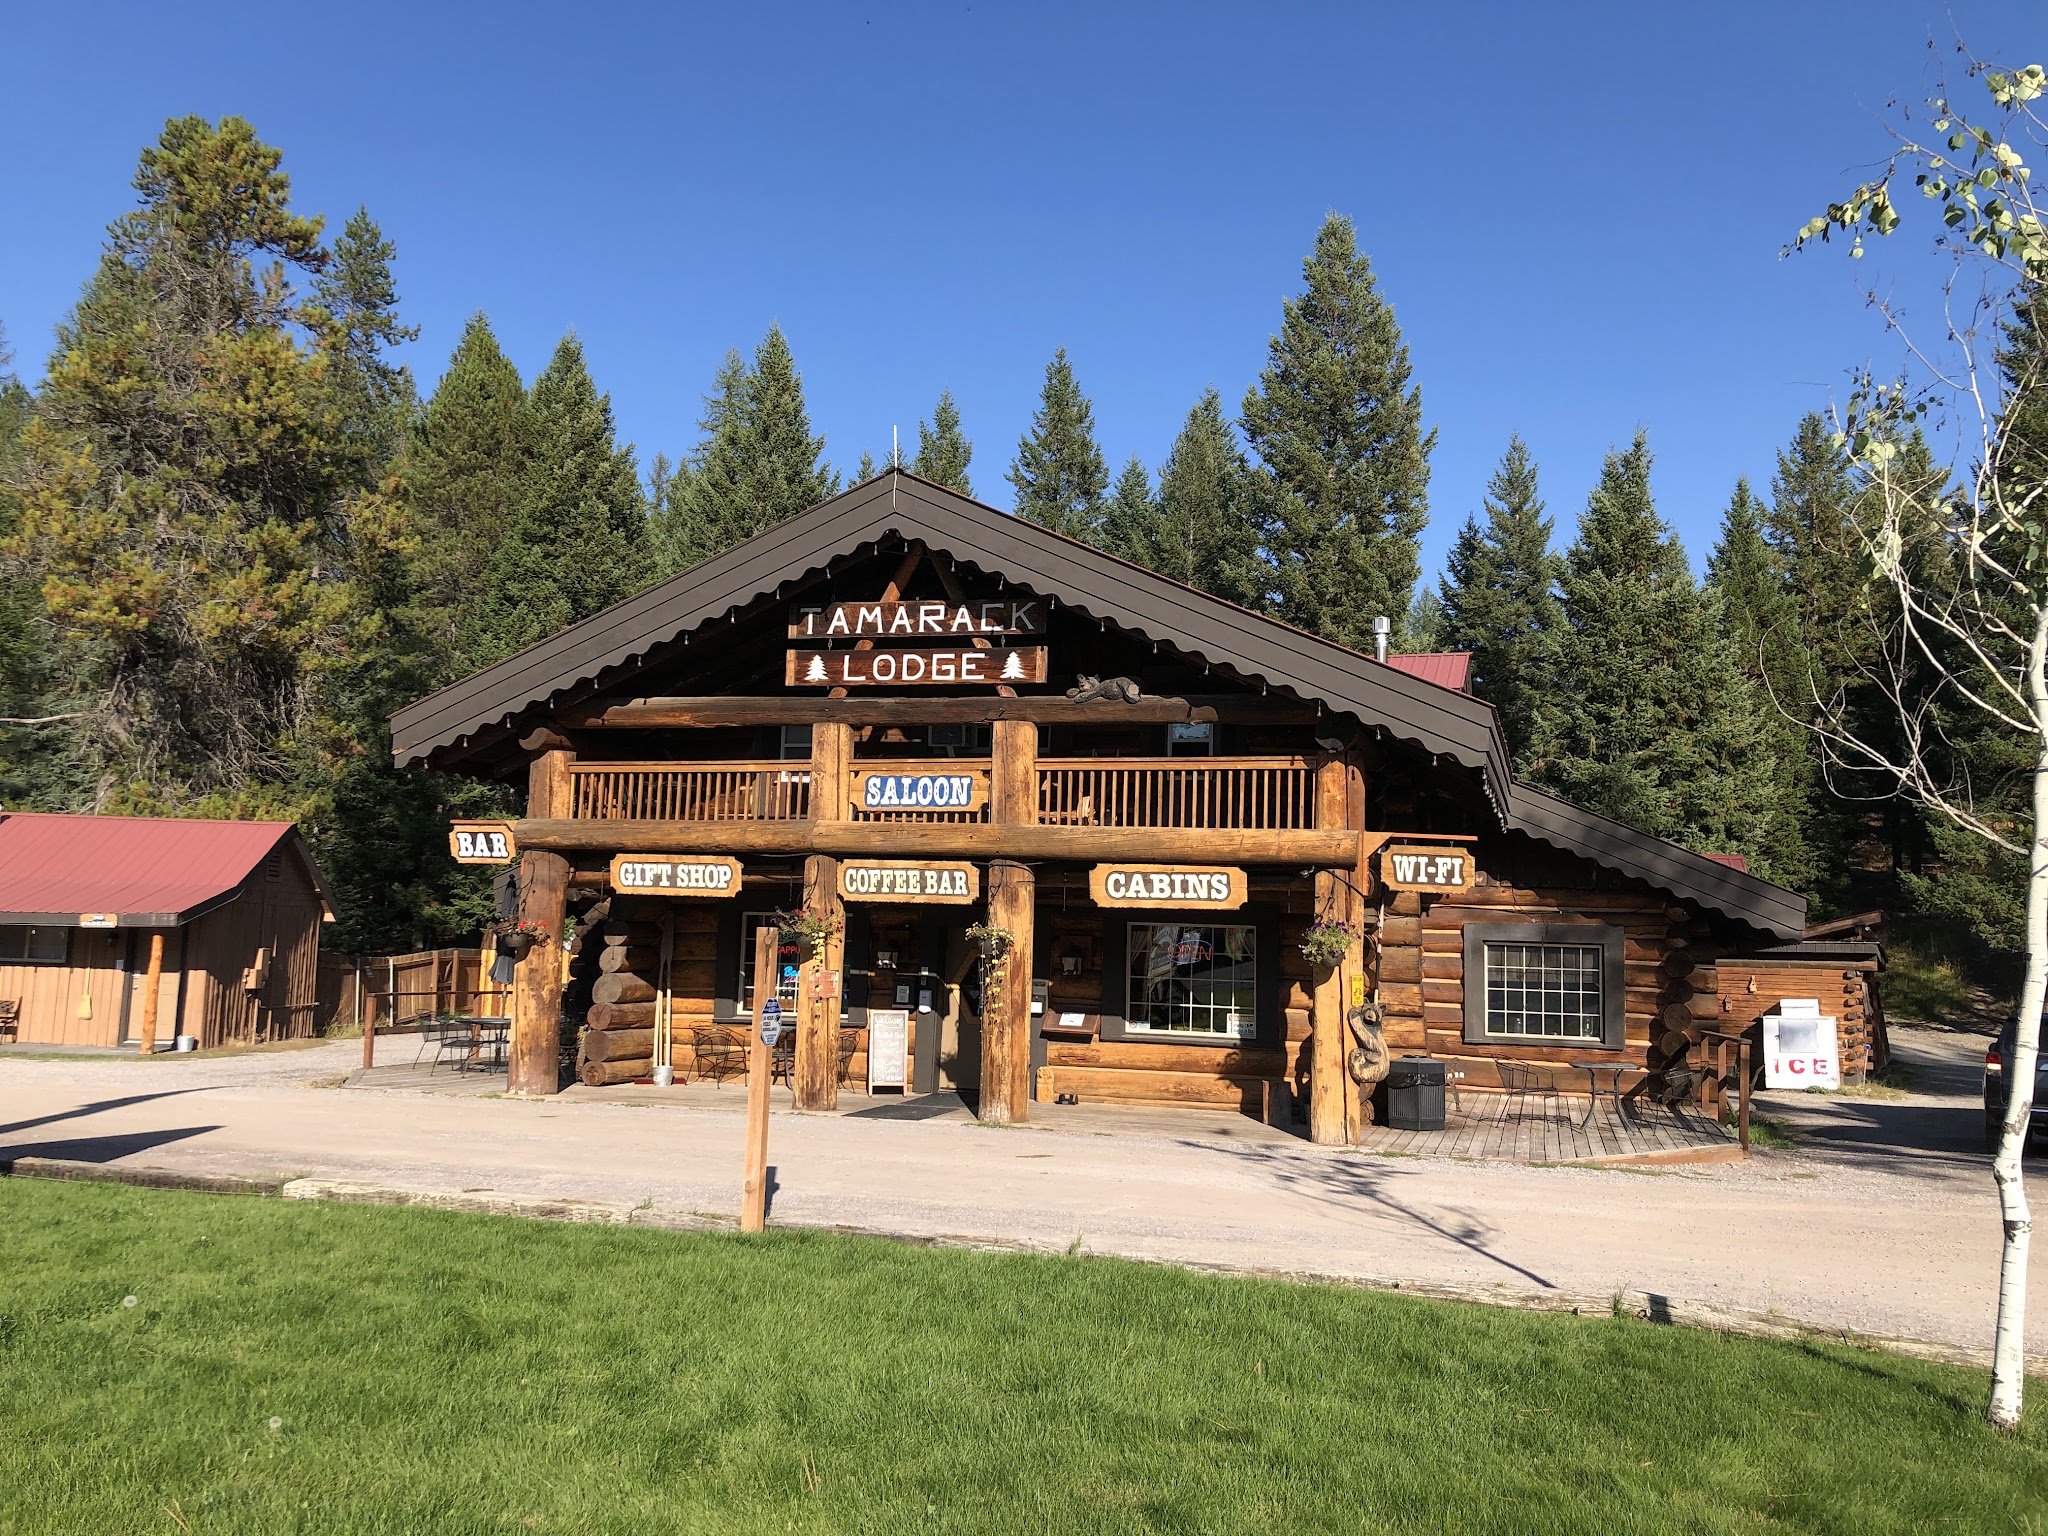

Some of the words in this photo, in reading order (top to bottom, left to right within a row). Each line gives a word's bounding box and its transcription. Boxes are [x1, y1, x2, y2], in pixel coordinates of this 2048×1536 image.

[800, 602, 1037, 634] TAMARACK
[843, 652, 986, 681] LODGE
[866, 777, 971, 805] SALOON
[457, 832, 508, 858] BAR
[619, 863, 672, 887] GIFT
[676, 865, 732, 889] SHOP
[845, 868, 921, 894] COFFEE
[925, 871, 968, 895] BAR
[1393, 855, 1463, 885] WI-FI
[1107, 872, 1229, 900] CABINS
[1167, 943, 1213, 961] OPEN
[1773, 1058, 1828, 1075] ICE
